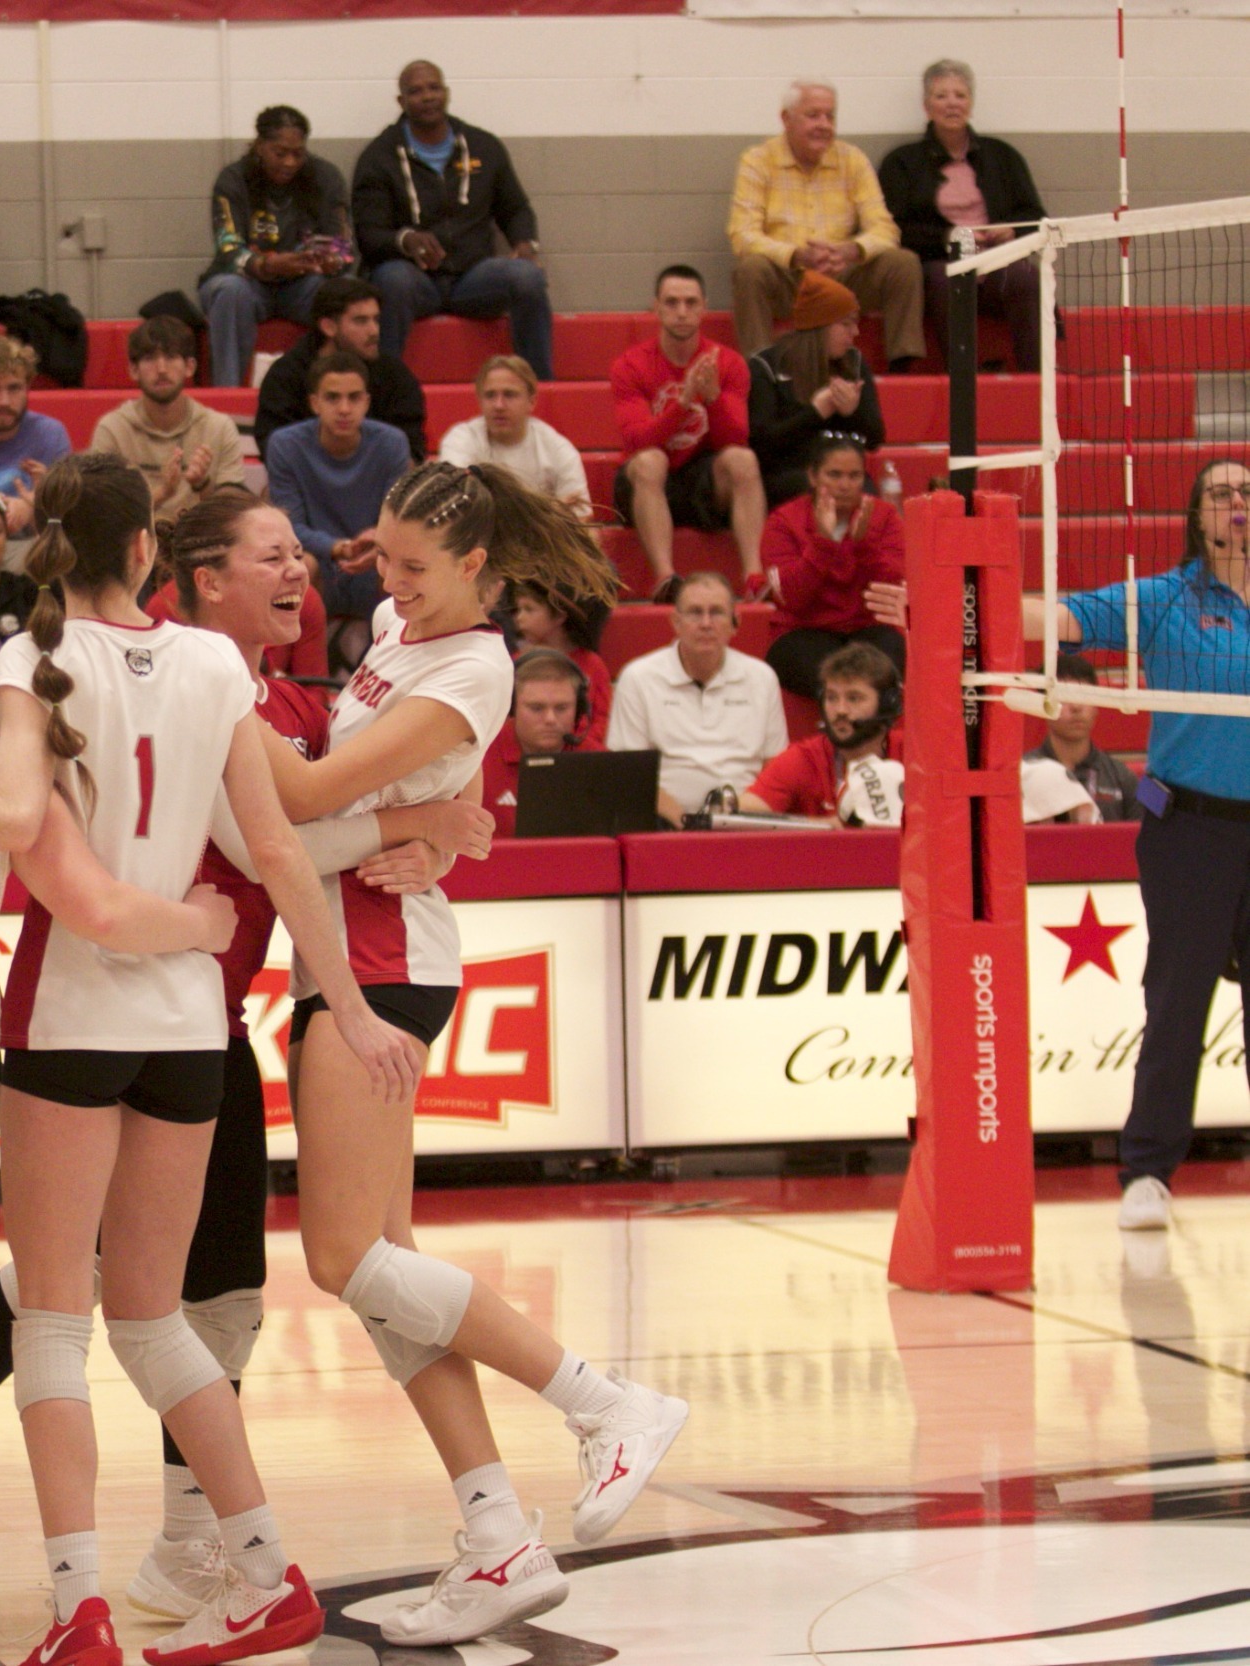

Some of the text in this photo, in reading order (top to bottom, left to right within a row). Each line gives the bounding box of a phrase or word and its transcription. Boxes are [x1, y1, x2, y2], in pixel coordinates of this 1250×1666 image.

[133, 733, 156, 840] 1
[648, 930, 909, 1001] MIDW
[784, 1025, 914, 1085] Com
[970, 953, 1001, 1143] sports imports
